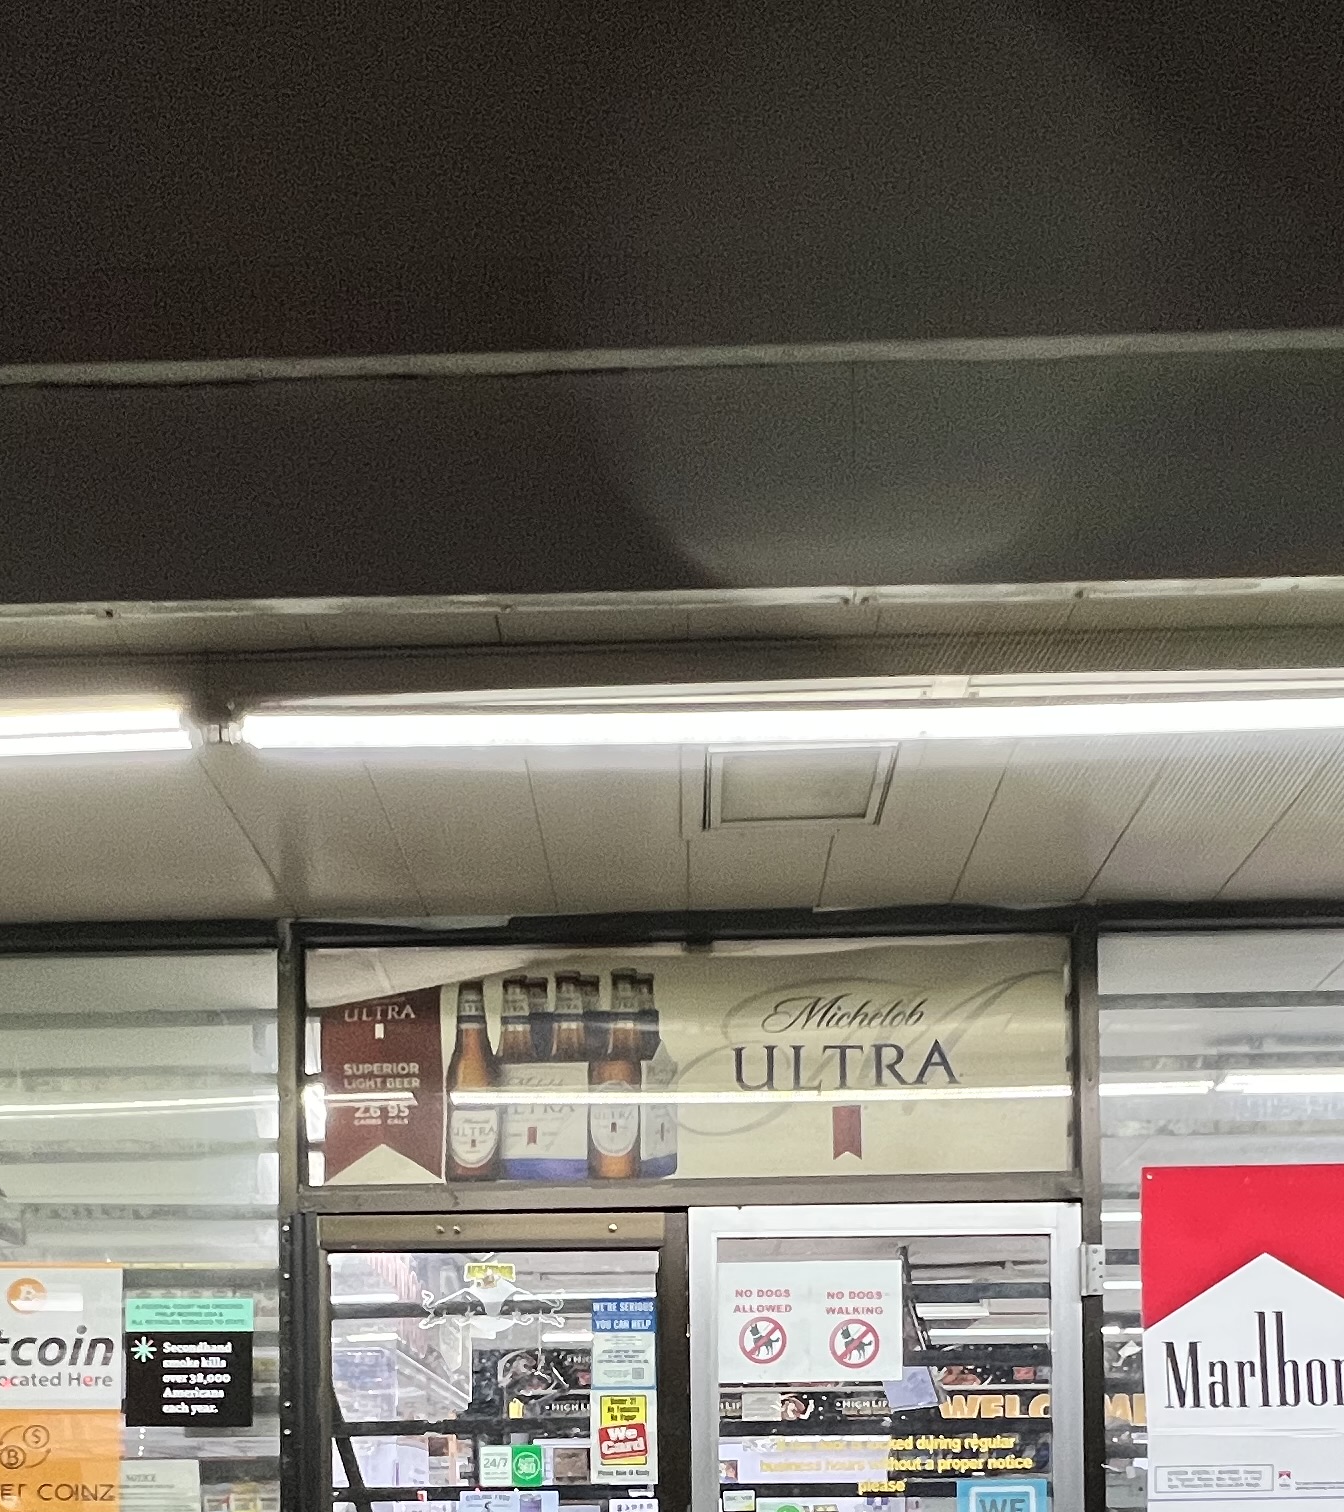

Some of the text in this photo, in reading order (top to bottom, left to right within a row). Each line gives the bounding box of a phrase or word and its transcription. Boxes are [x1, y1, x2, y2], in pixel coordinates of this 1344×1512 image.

[344, 1004, 416, 1022] ULTRA
[761, 992, 929, 1034] Michelob
[343, 1062, 419, 1075] SUPERIOR
[734, 1038, 962, 1091] ULTRA
[343, 1077, 420, 1089] LIGHT BEER
[735, 1289, 791, 1298] NO DOGS
[826, 1291, 883, 1300] NO DOGS
[619, 1302, 654, 1312] SERIOUS
[733, 1304, 793, 1313] ALLOWED
[825, 1306, 884, 1315] WALKING
[596, 1319, 652, 1330] YOU CAN HELP
[162, 1341, 233, 1353] Secondhand
[162, 1356, 199, 1368] smoke
[68, 1371, 113, 1387] Here
[162, 1386, 225, 1399] Americans
[162, 1401, 189, 1414] each
[606, 1426, 638, 1441] We
[601, 1436, 646, 1455] Card
[916, 1433, 1016, 1453] during regular
[483, 1458, 508, 1468] 24/7
[937, 1457, 984, 1473] proper
[986, 1455, 1034, 1470] notice
[37, 1482, 116, 1502] COINZ
[858, 1479, 907, 1495] please
